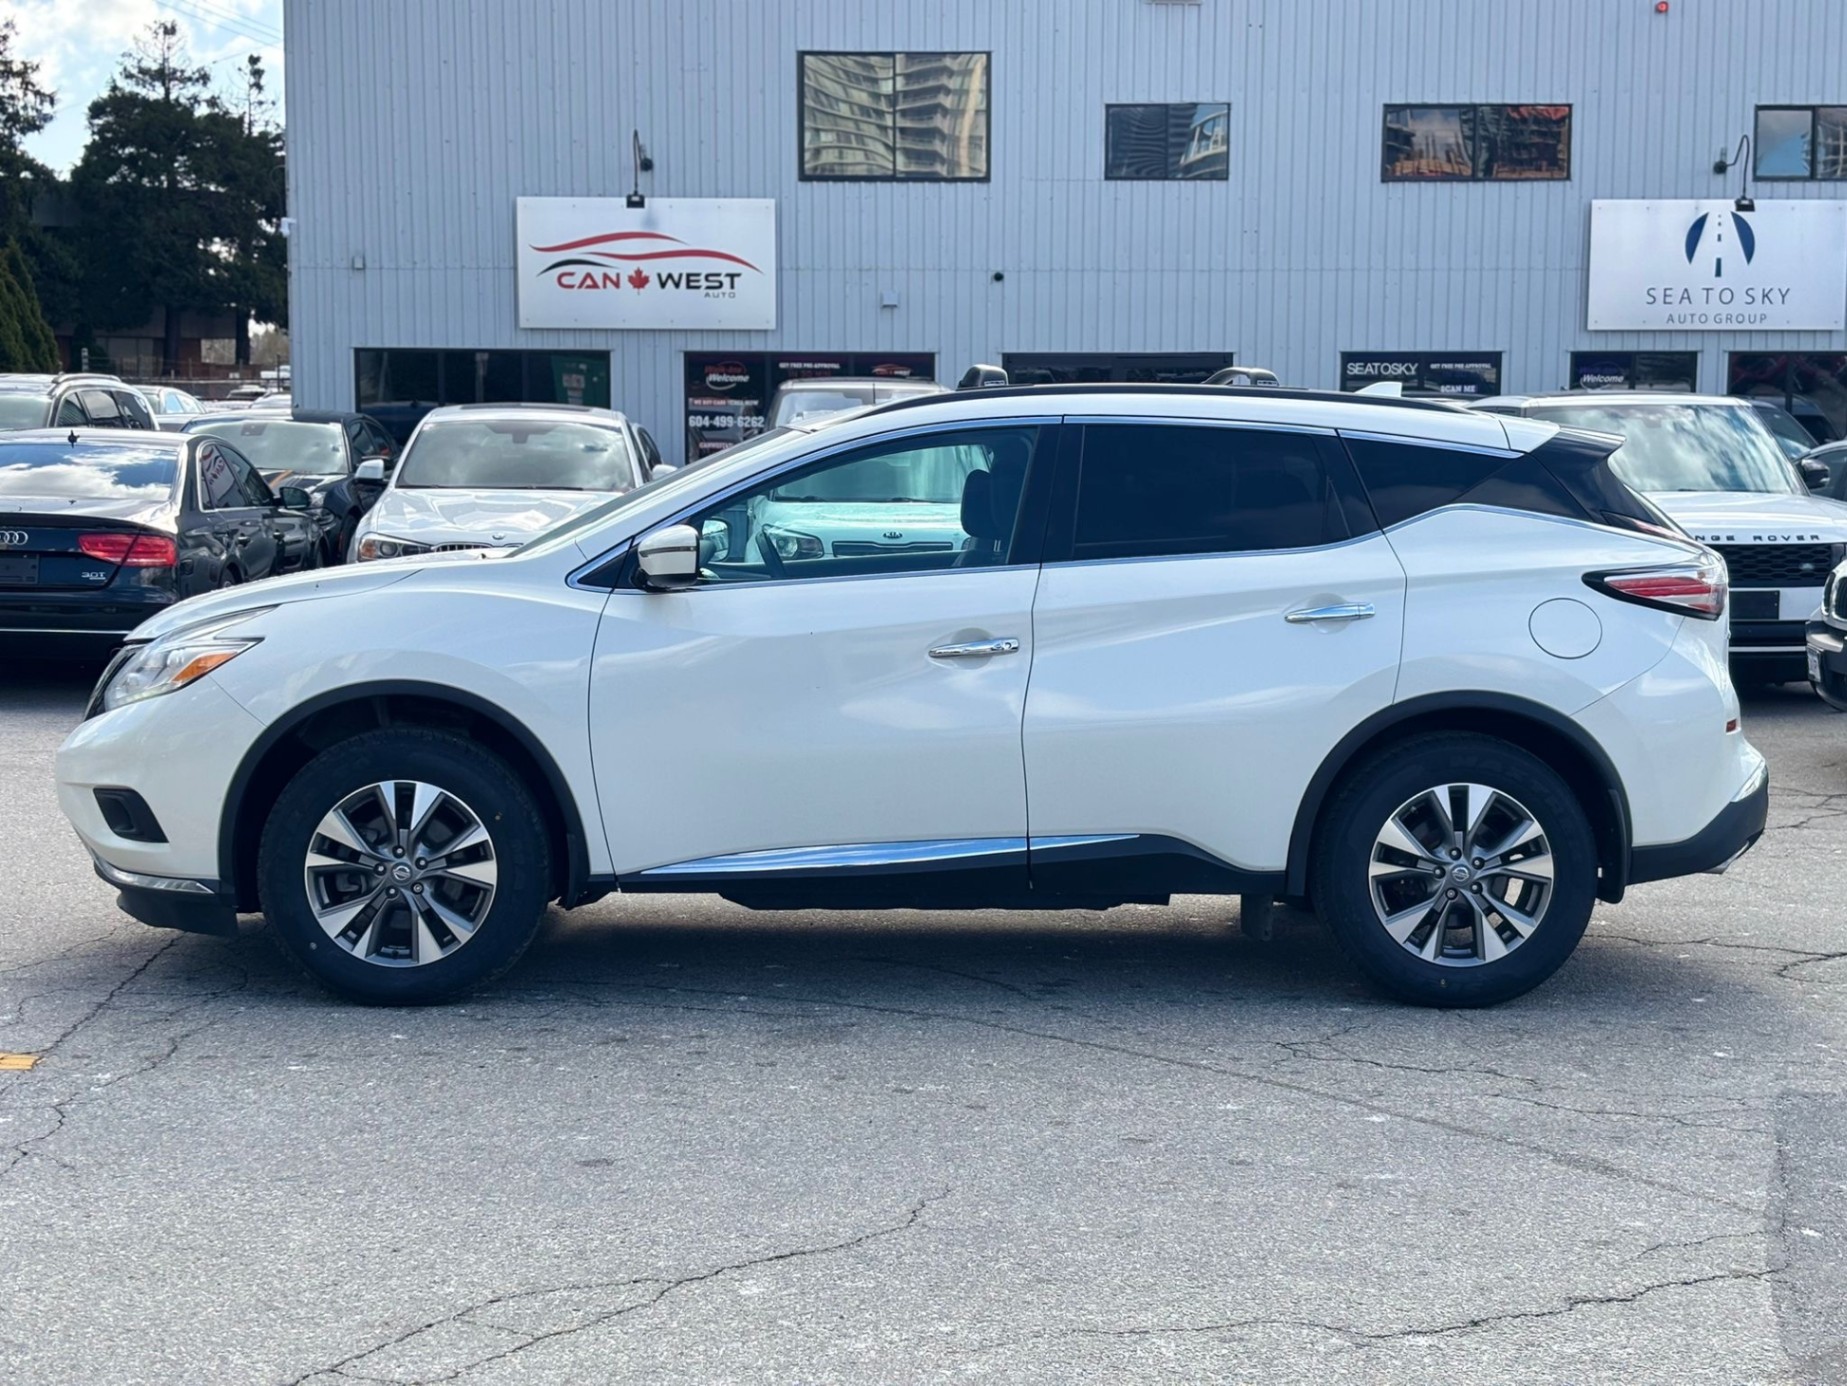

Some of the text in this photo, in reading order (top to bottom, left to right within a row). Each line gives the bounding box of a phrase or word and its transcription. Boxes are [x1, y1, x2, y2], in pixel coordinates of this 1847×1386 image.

[556, 271, 742, 290] CAN WEST
[1646, 287, 1791, 305] SEA TO SKY
[1666, 313, 1768, 325] AUTO GROUP
[1346, 362, 1419, 376] SEATOSKY
[708, 373, 750, 383] Welcome
[1583, 374, 1624, 383] Welcome
[1440, 385, 1476, 393] SCAN ME
[688, 415, 765, 428] 604-499-6262
